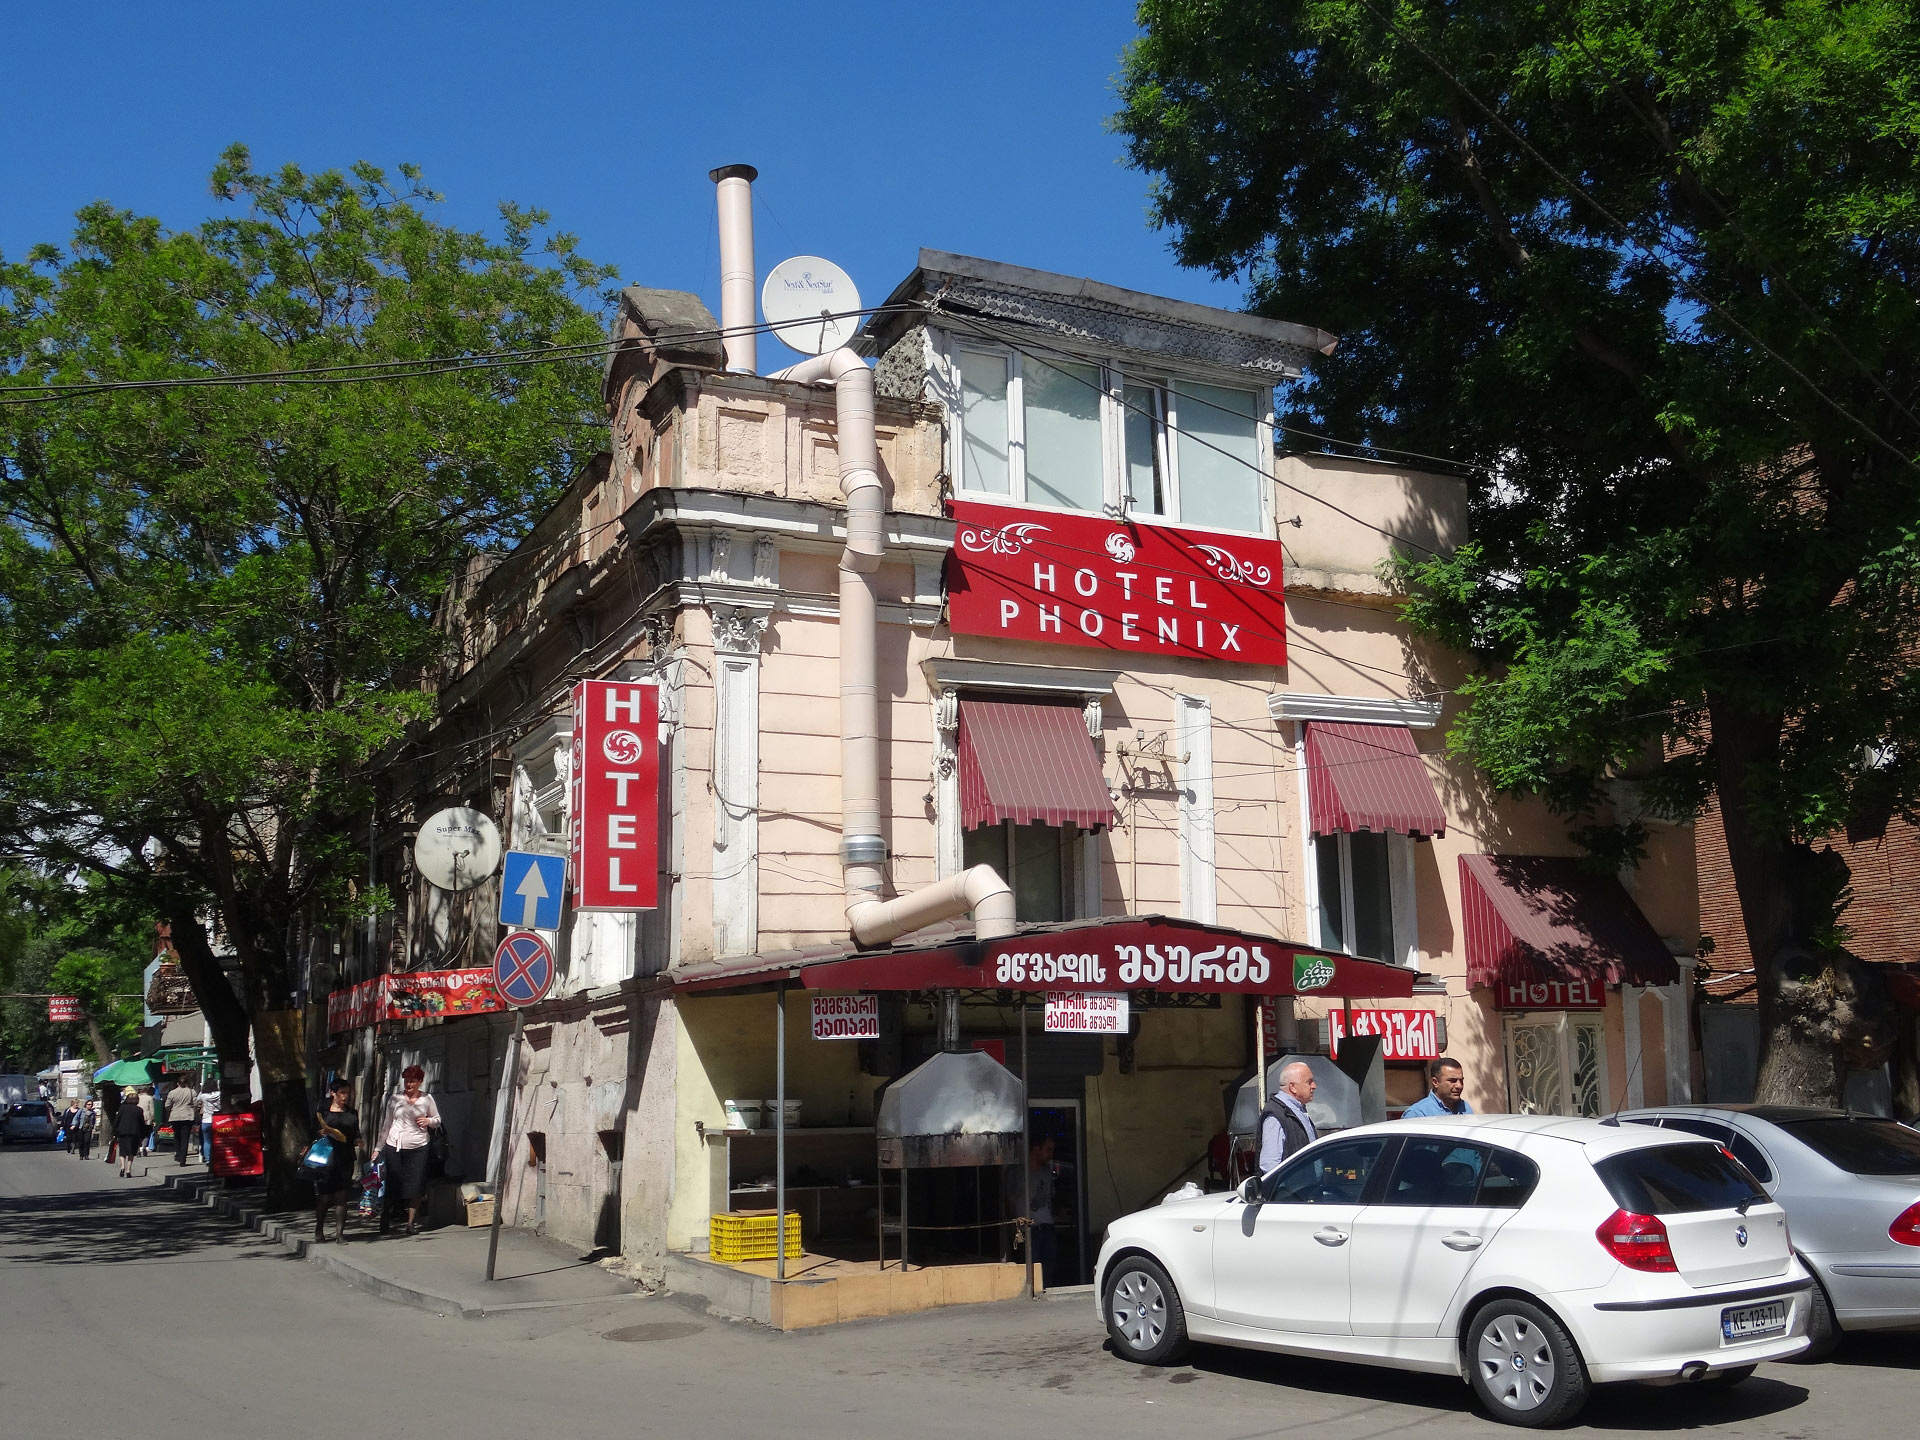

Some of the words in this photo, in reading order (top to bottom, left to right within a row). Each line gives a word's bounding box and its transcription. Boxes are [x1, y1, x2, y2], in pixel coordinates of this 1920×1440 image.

[1033, 561, 1208, 610] HOTEL
[1000, 599, 1242, 652] PHOENIX
[603, 687, 643, 893] HOTEL
[436, 826, 461, 834] Super
[463, 825, 481, 836] Max
[996, 952, 1107, 983] მწვადის
[1114, 944, 1271, 984] შაურმა
[389, 976, 446, 989] ყველაფერი
[463, 973, 494, 985] ლარა
[1509, 980, 1599, 1004] HOTEL
[813, 996, 877, 1016] შემწვარი
[1046, 991, 1088, 1010] ღორის
[813, 1017, 878, 1037] ქათამი
[1046, 1010, 1088, 1029] ქათმის
[1732, 1305, 1778, 1331] KE-123-TI
